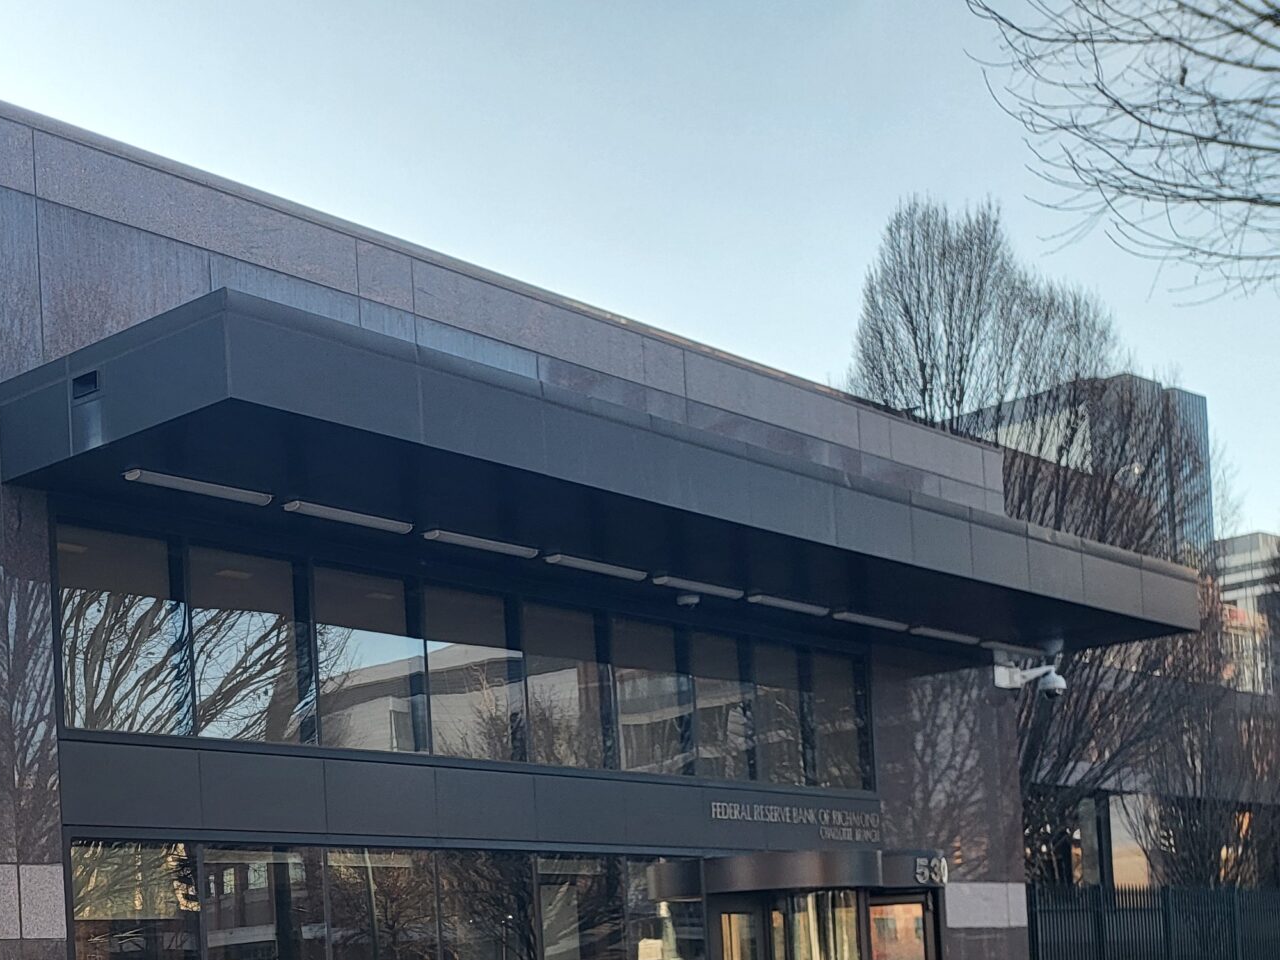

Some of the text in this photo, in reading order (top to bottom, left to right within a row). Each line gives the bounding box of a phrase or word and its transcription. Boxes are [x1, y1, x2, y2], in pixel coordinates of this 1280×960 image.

[711, 802, 880, 828] FEDERAL RESERVE BANK OF RICHMOND
[915, 856, 949, 884] 530
